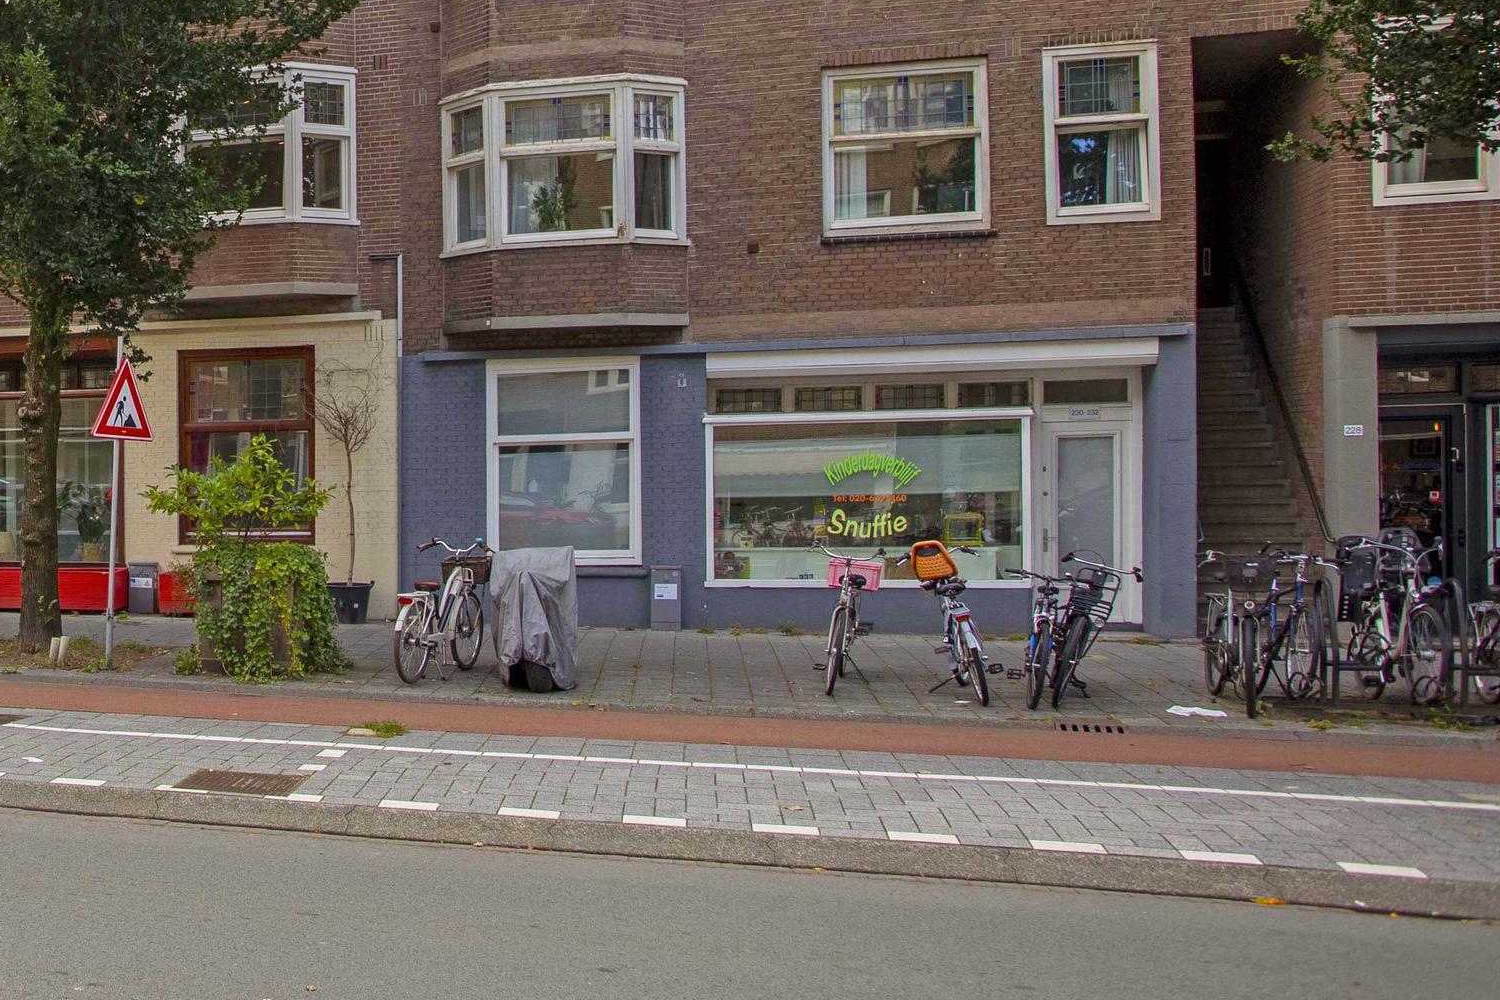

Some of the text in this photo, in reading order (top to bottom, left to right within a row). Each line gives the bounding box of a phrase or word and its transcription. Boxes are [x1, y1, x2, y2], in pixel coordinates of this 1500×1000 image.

[1345, 426, 1361, 435] 228
[823, 449, 922, 490] Kinderdagverblijf
[826, 508, 908, 538] Snuffie
